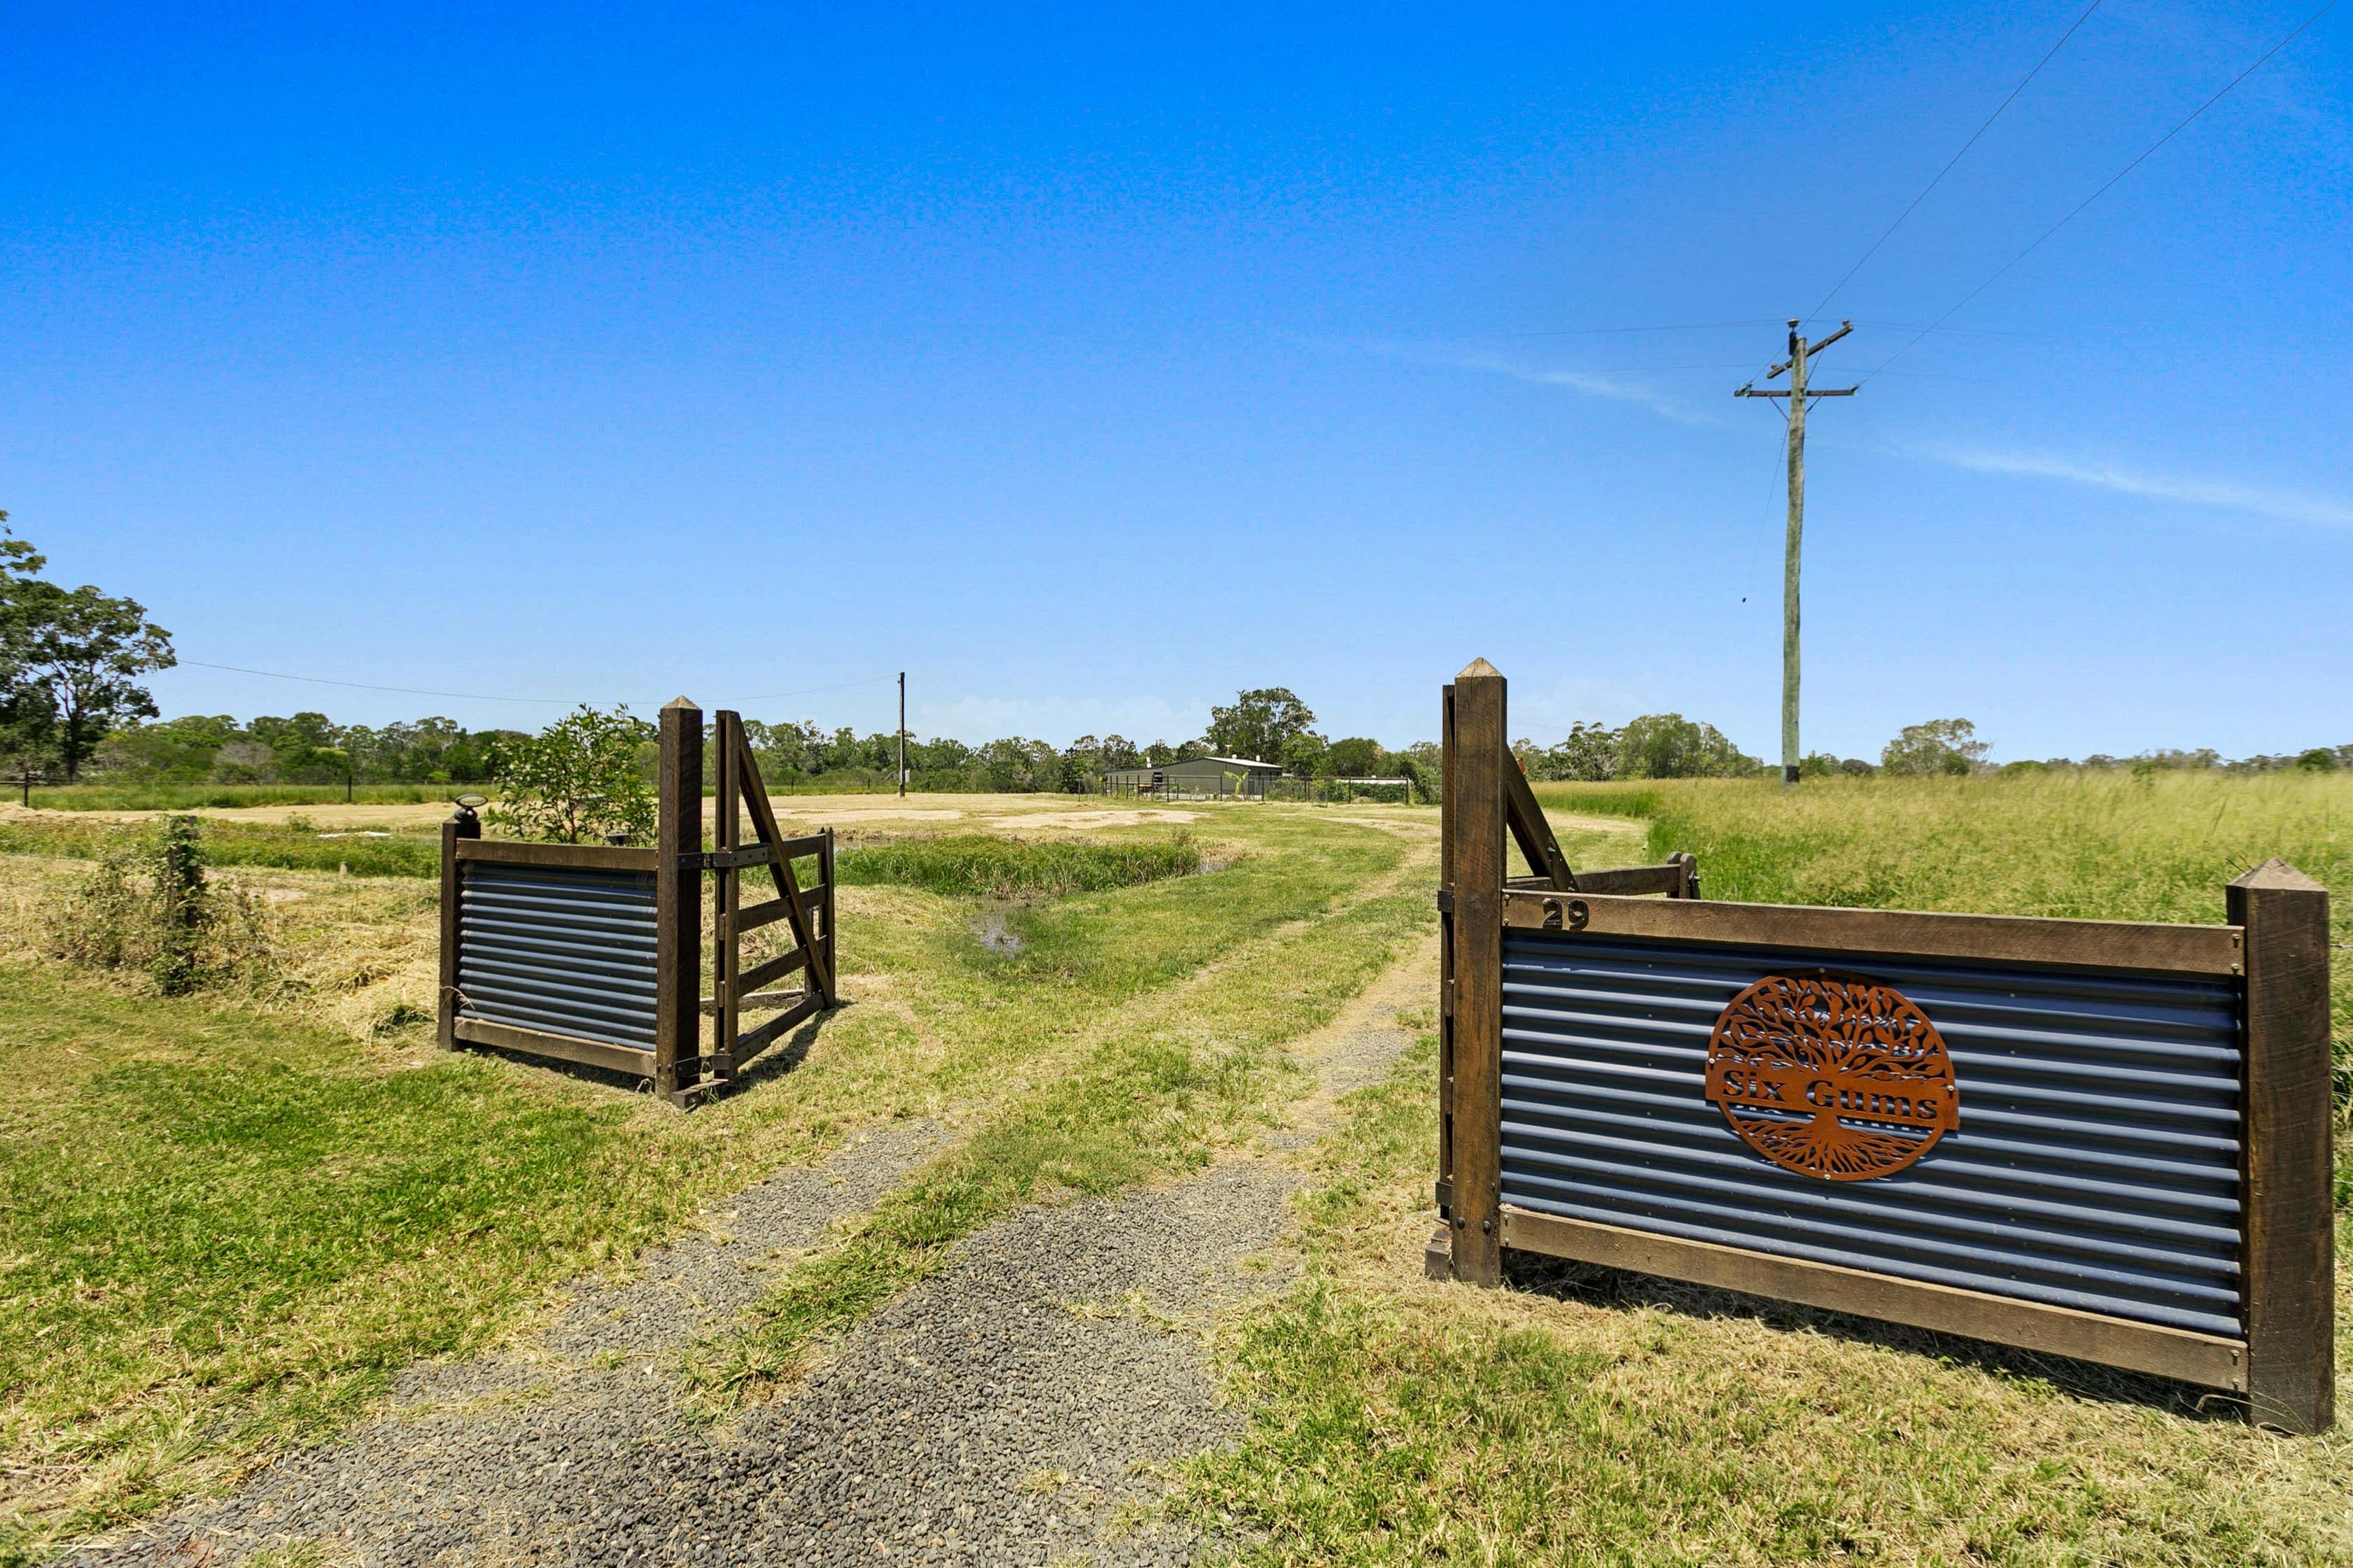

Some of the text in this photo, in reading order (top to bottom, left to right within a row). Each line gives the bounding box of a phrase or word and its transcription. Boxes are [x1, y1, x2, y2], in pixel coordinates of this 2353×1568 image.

[1543, 898, 1589, 931] 29
[1722, 1069, 1938, 1120] Six Gums
